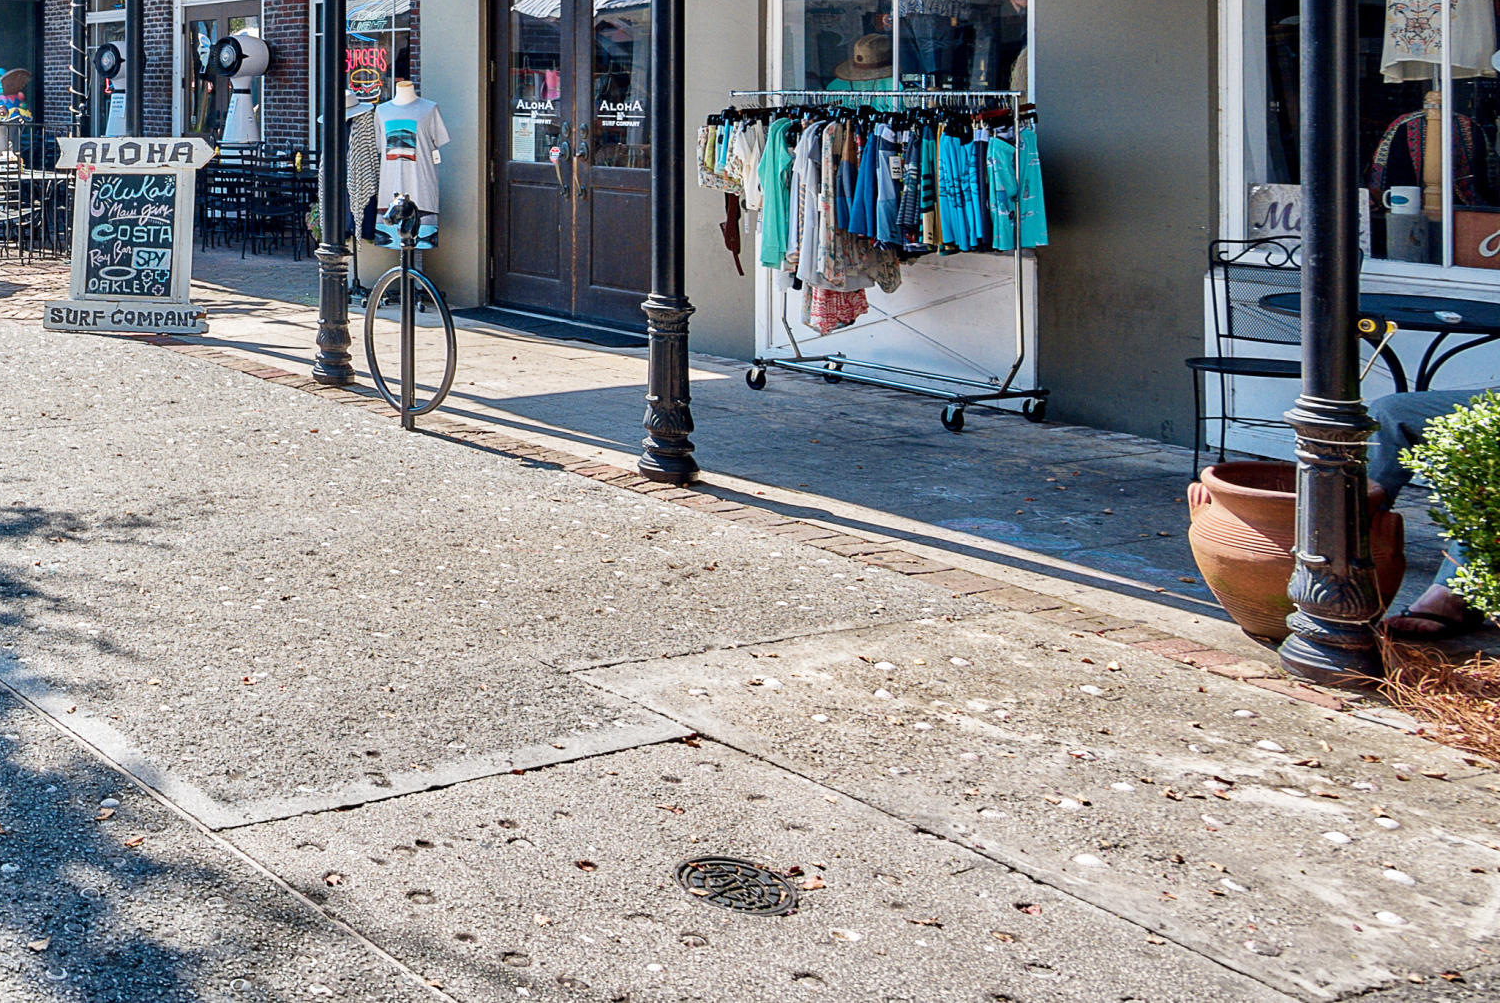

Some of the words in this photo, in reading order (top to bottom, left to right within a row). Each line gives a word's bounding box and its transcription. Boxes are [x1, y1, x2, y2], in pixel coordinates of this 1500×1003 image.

[345, 47, 387, 73] BURGERS
[516, 99, 554, 110] ALOHA
[600, 100, 643, 112] ALOHA
[77, 141, 193, 165] ALOHA
[91, 224, 172, 243] COSTA
[136, 250, 167, 267] SPY
[88, 279, 152, 293] OAKLEY
[50, 307, 105, 327] SURF
[110, 309, 201, 328] COMPANY
